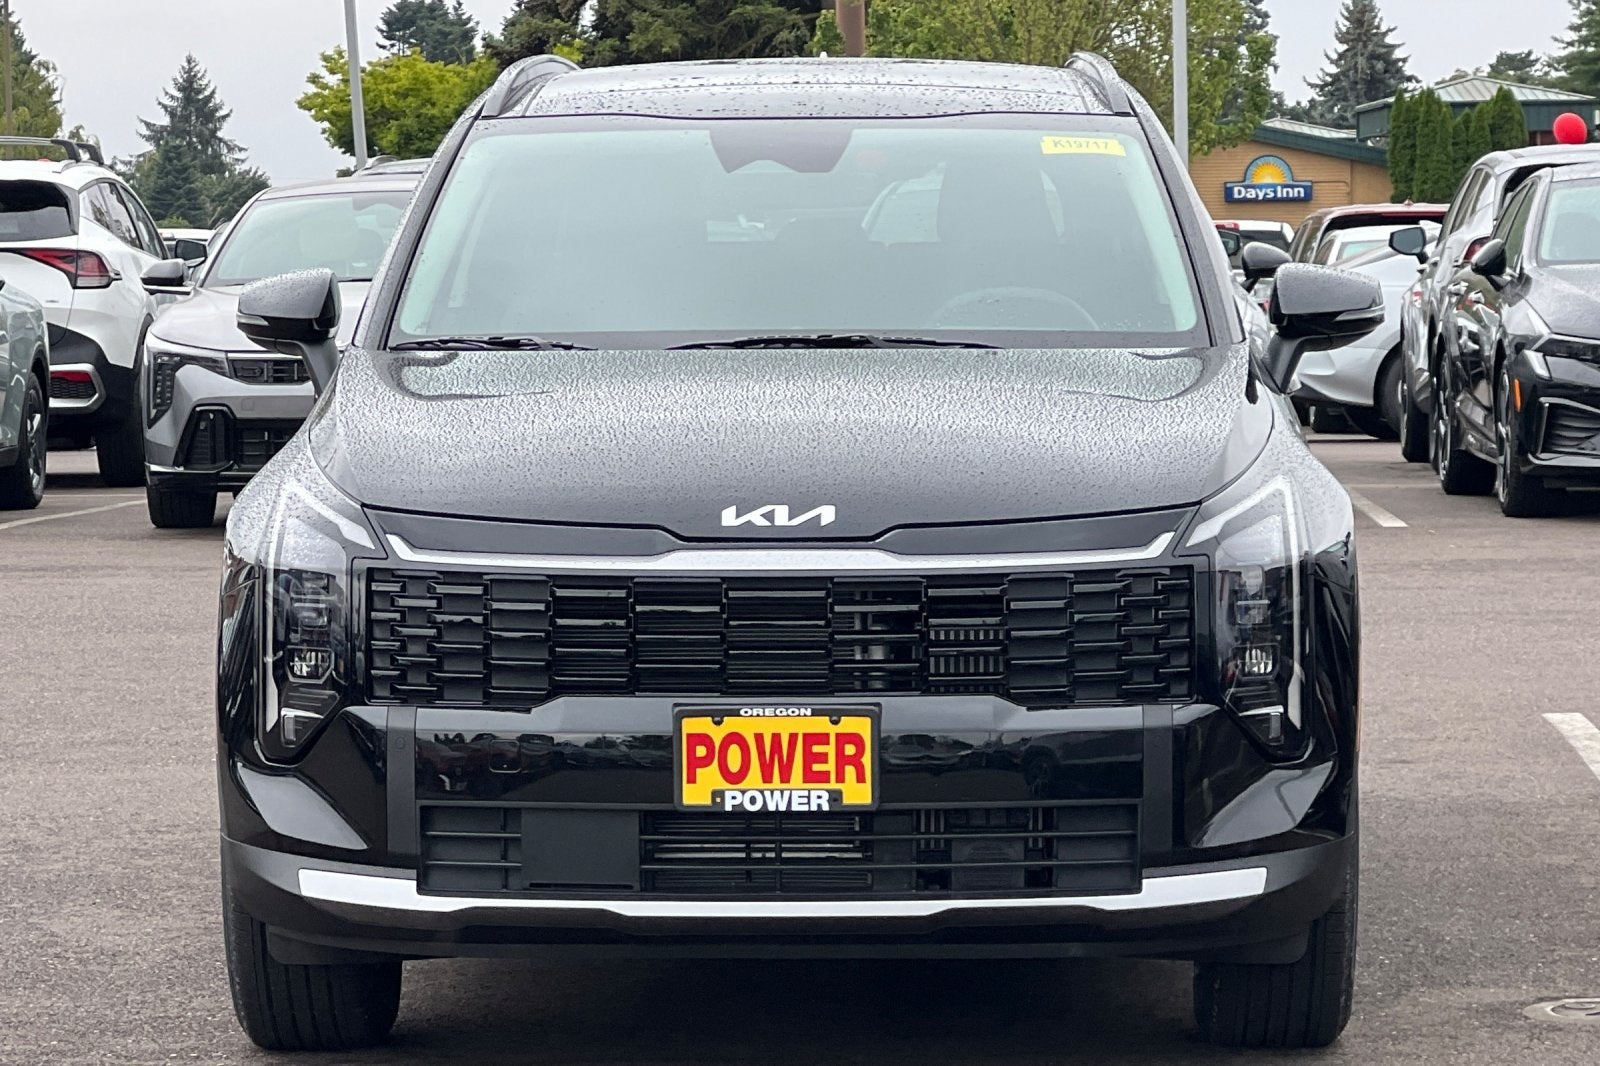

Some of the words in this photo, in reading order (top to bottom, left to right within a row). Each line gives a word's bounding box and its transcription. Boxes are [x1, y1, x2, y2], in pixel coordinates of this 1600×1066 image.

[1233, 186, 1275, 200] Days
[1276, 185, 1305, 198] Inn
[739, 707, 812, 716] OREGON
[686, 731, 867, 785] POWER
[724, 790, 830, 812] POWER
